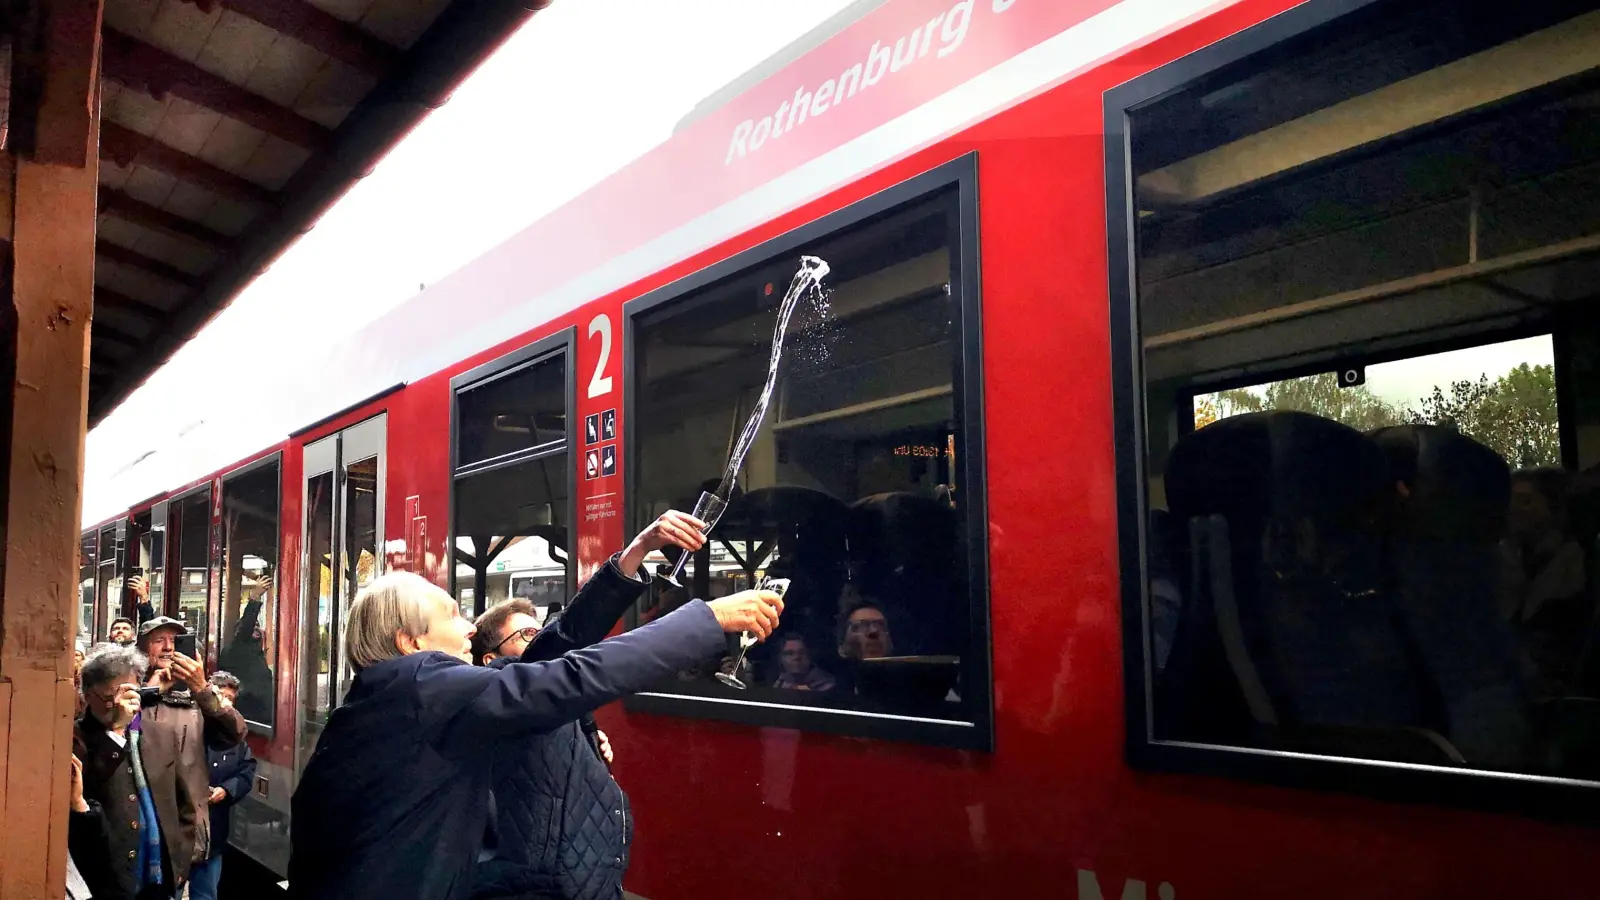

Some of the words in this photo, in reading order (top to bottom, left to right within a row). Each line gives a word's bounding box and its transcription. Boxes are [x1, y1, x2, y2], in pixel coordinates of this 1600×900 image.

[725, 0, 975, 166] Rothenburg
[587, 313, 613, 399] 2
[214, 477, 220, 517] 2
[420, 521, 425, 536] 2
